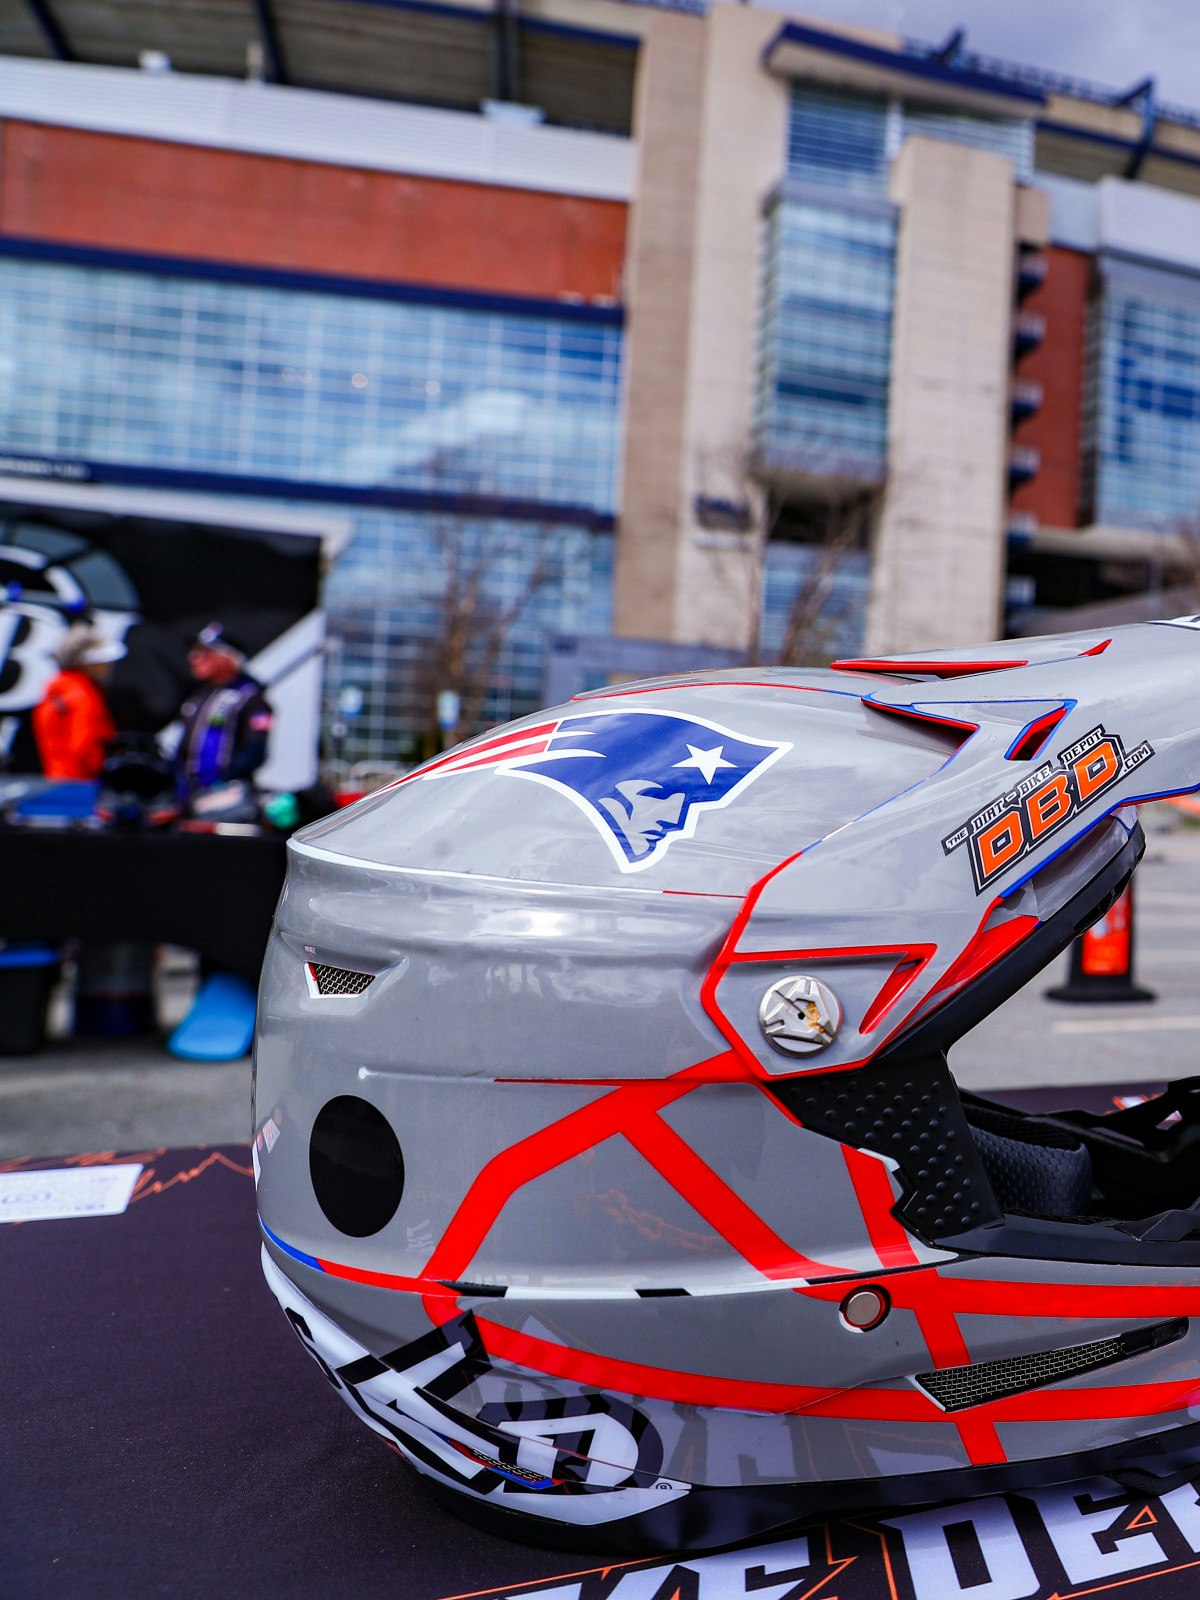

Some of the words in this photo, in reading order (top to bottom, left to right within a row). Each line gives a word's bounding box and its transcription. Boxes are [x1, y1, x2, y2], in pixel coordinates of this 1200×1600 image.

[946, 829, 968, 850] THE
[1062, 729, 1103, 764] DEPOT
[976, 739, 1120, 878] DBD
